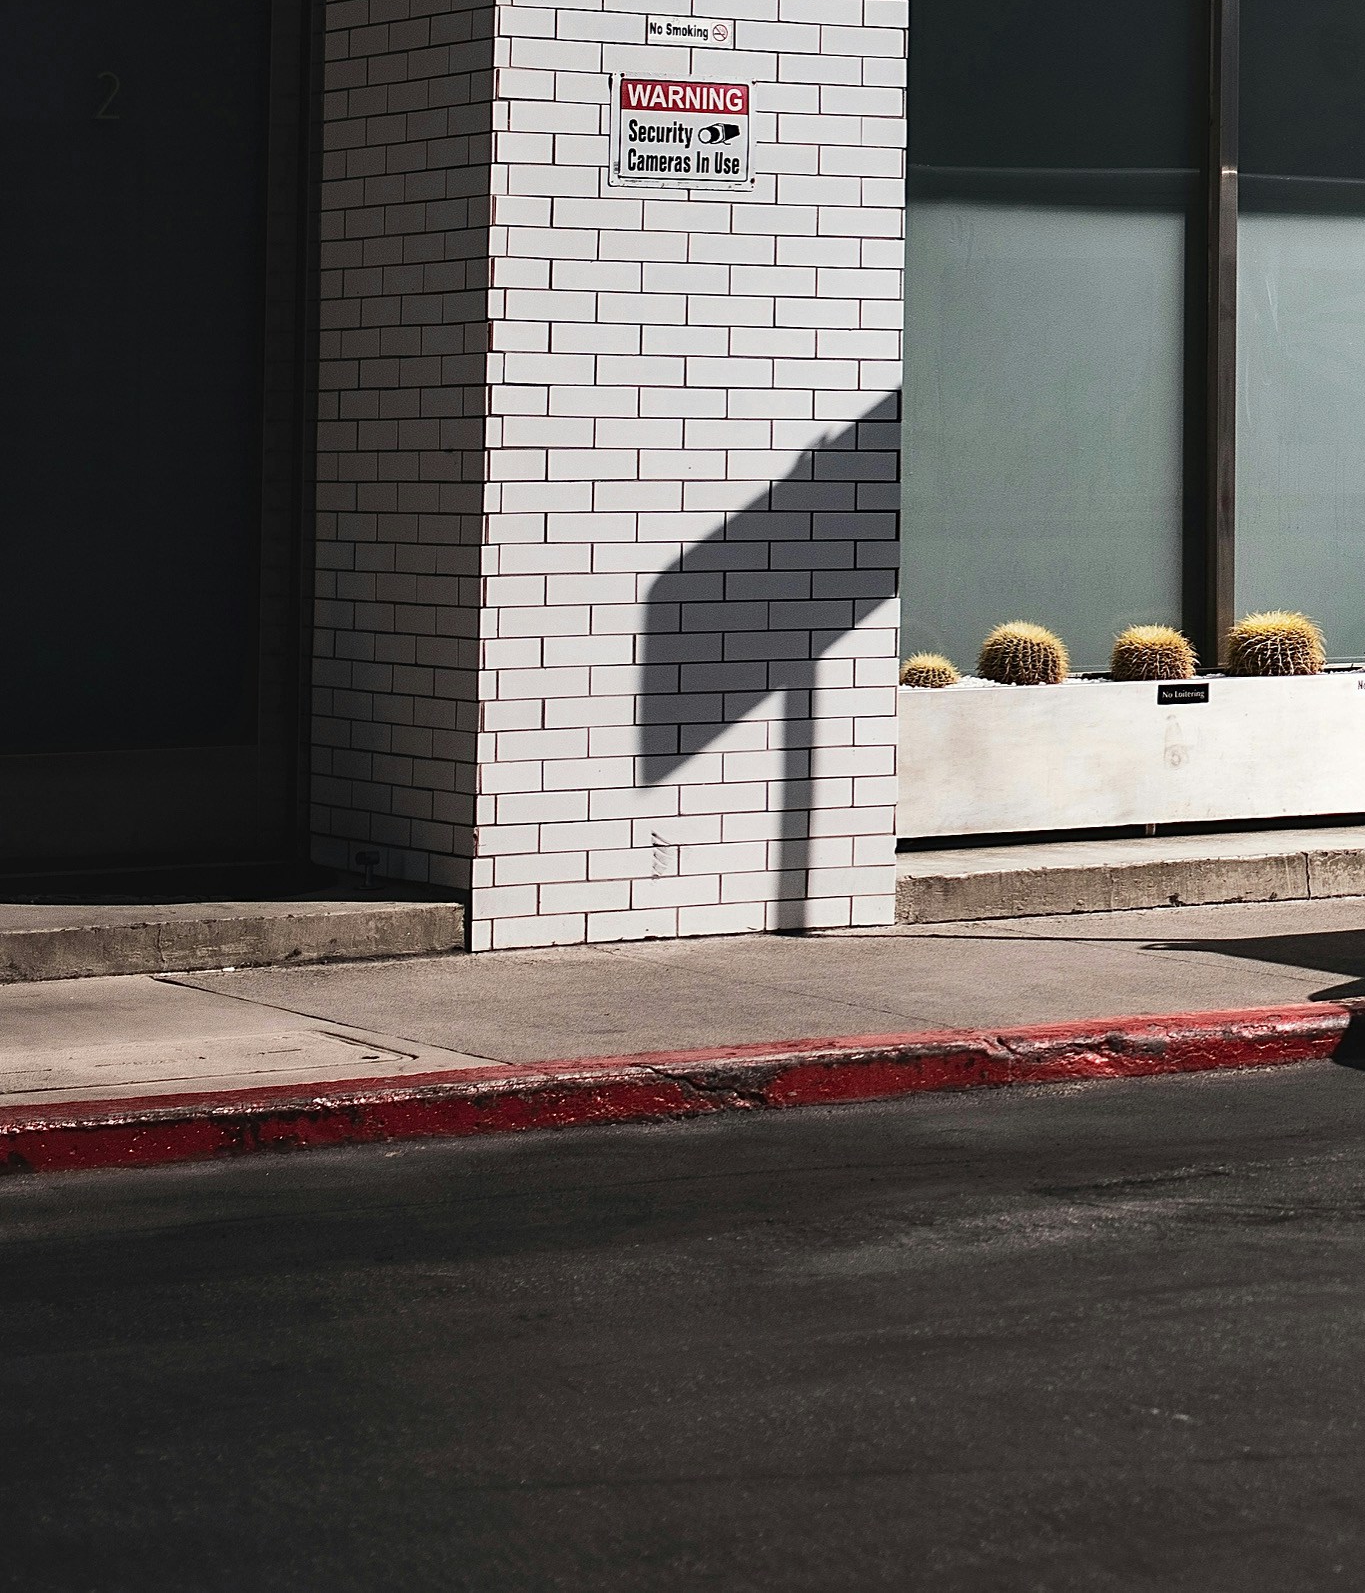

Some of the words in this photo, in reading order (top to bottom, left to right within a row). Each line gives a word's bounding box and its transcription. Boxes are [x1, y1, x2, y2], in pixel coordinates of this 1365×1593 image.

[649, 22, 663, 36] No
[666, 23, 709, 41] Smoking
[95, 71, 120, 119] 2
[627, 83, 743, 112] WARNING
[628, 119, 694, 149] Security
[627, 148, 691, 173] Cameras
[696, 151, 710, 174] In
[714, 152, 740, 175] Use
[1174, 689, 1205, 699] Loitering
